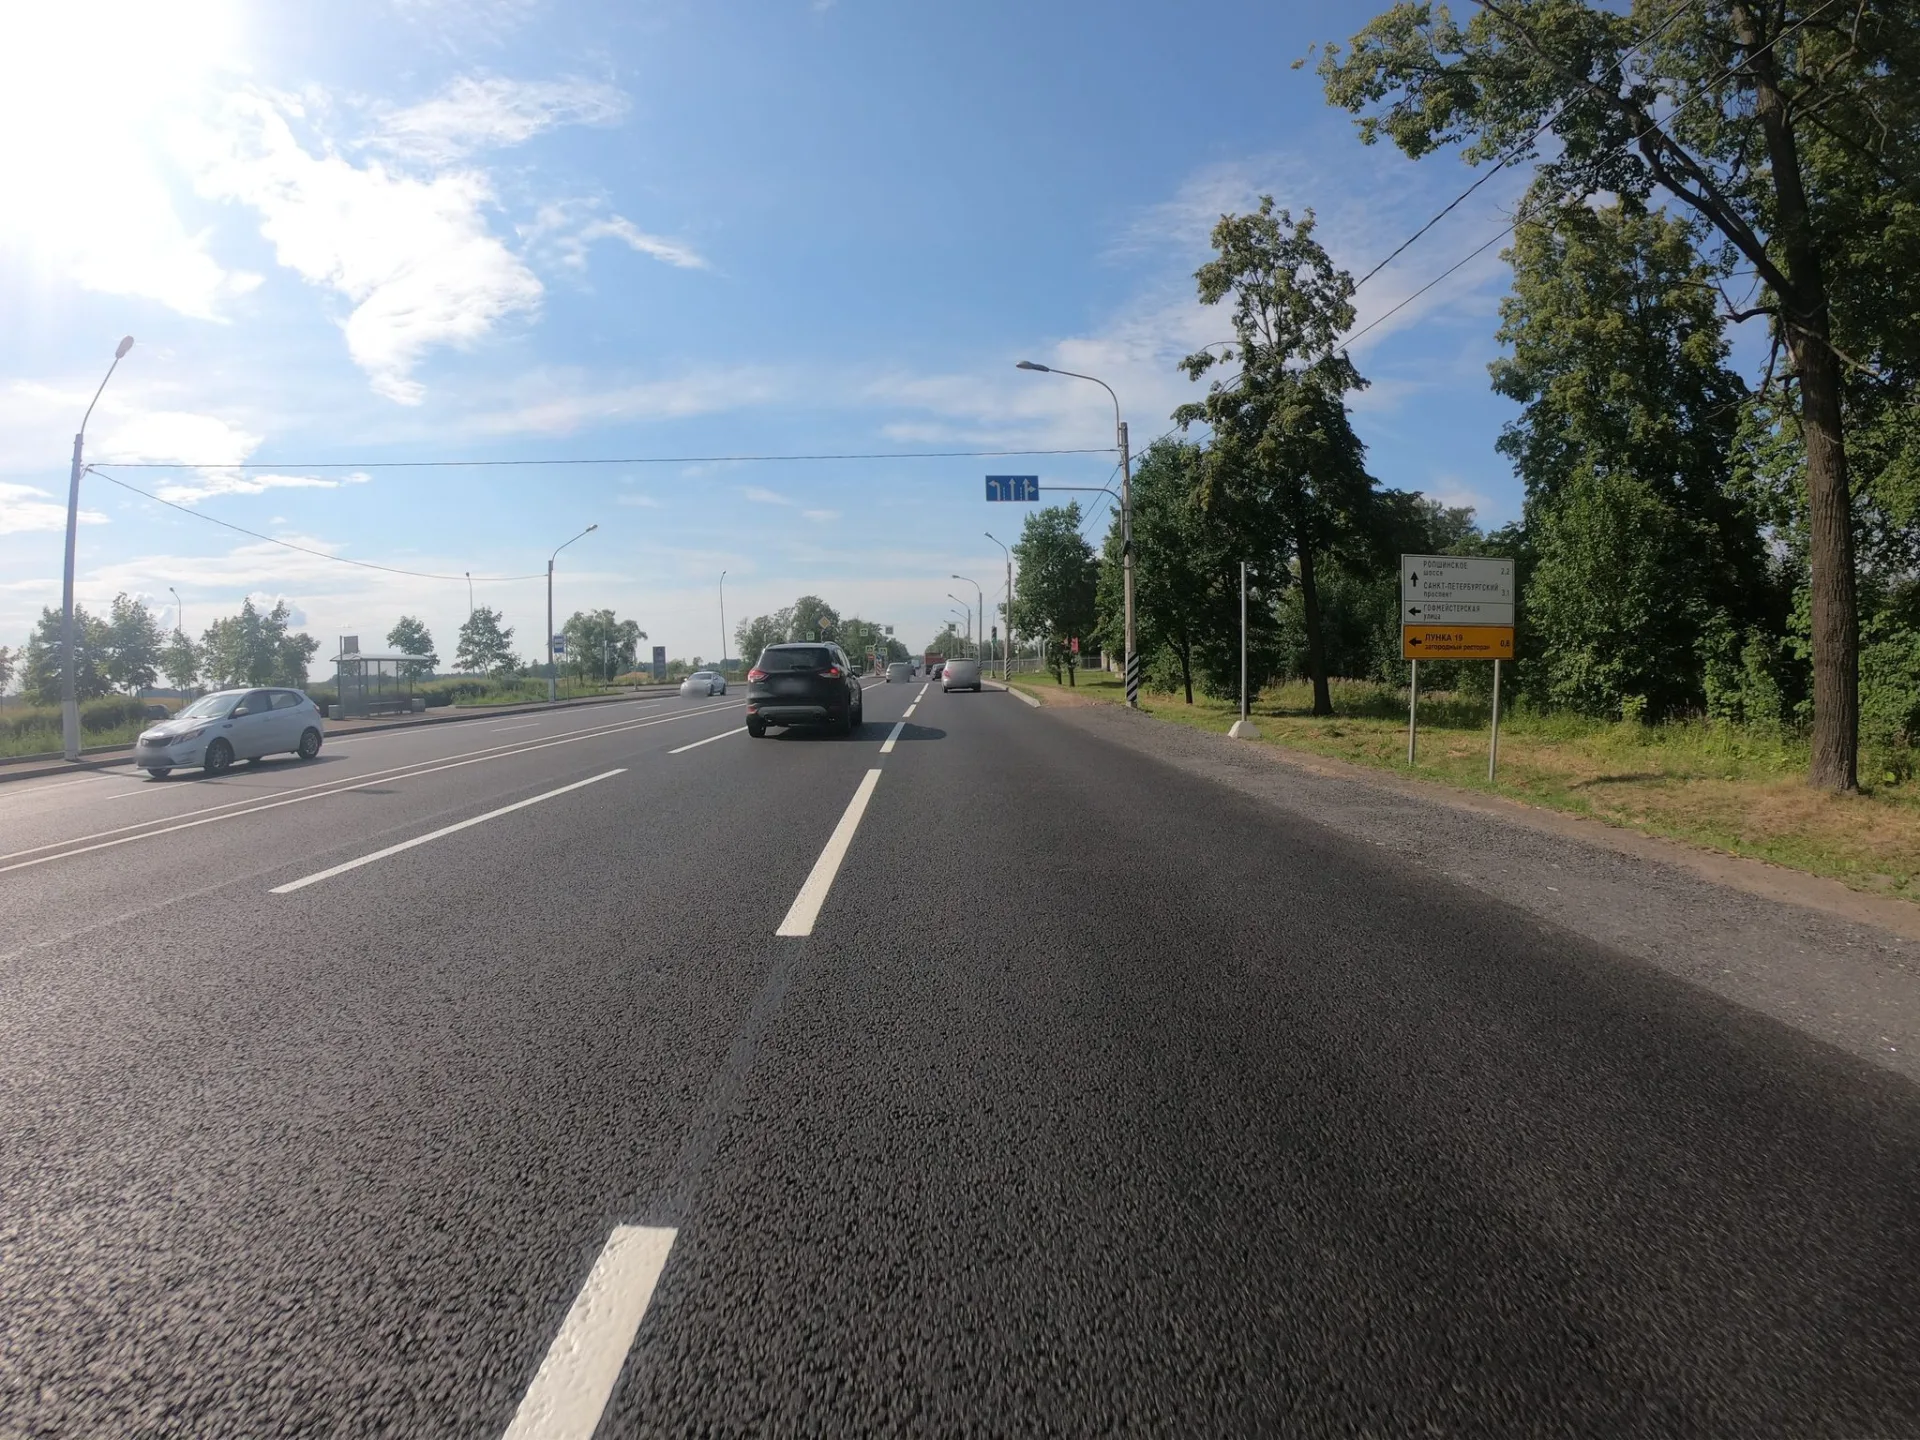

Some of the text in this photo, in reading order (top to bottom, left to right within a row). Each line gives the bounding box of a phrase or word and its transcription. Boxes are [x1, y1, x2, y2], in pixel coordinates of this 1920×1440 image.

[1424, 560, 1468, 570] РОПШИНСКОЕ
[1423, 581, 1499, 592] САНКТ-ПЕТЕРБУРГСКИЙ
[1423, 604, 1480, 612] ГОФМЕЙСТЕРСКАЯ
[1454, 634, 1464, 642] 19
